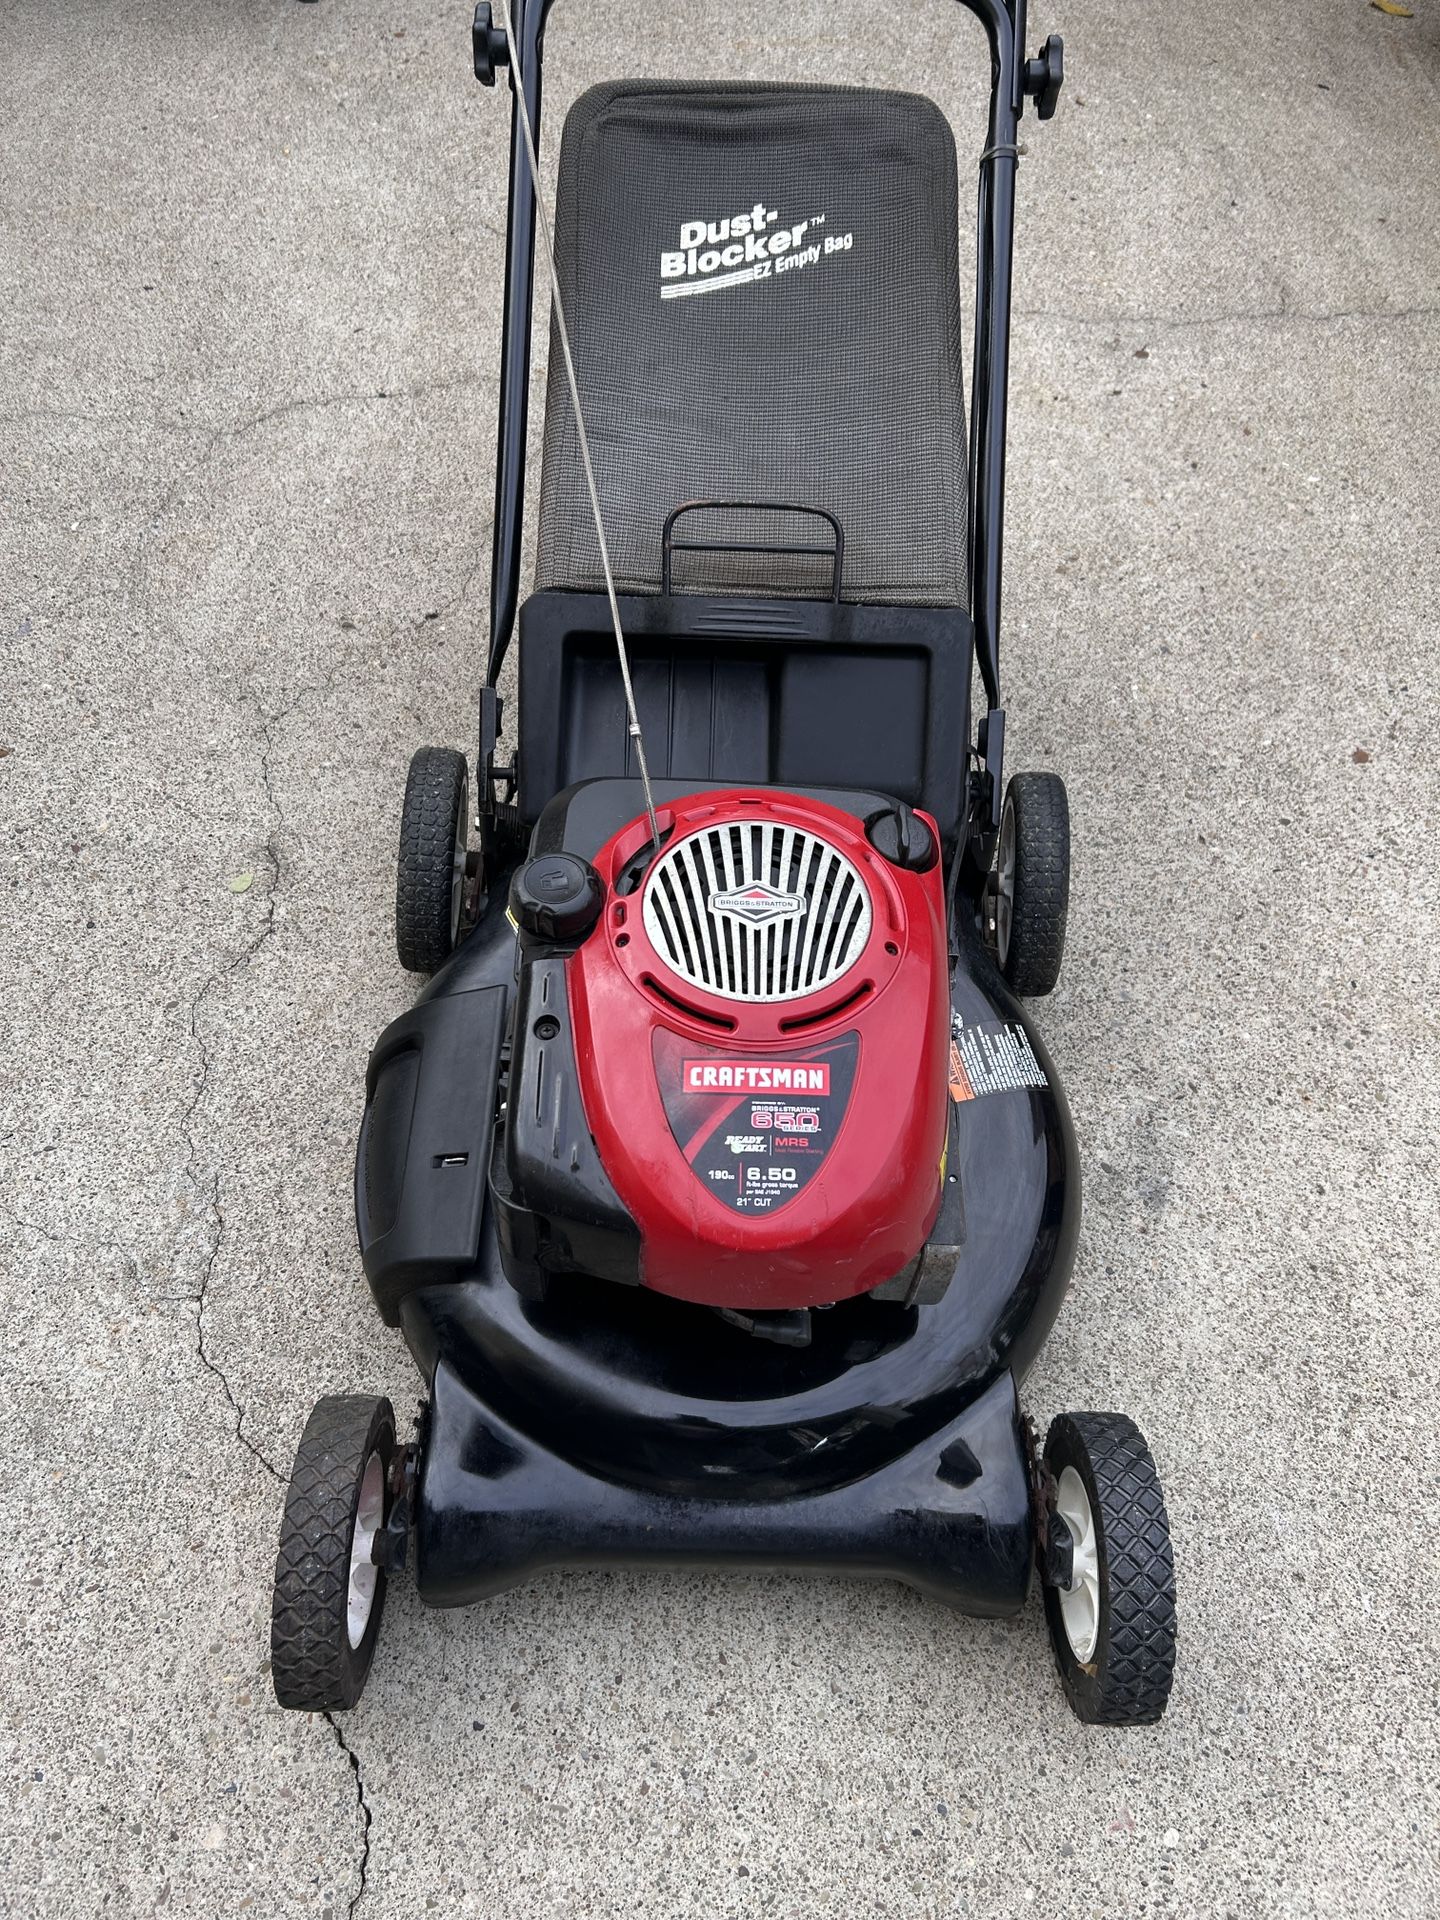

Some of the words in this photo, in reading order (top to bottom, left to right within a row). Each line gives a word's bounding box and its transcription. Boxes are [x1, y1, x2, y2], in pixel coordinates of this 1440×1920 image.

[680, 203, 778, 249] Dust-
[754, 261, 771, 279] EZ
[775, 245, 820, 272] Empty
[825, 233, 853, 254] Bag
[690, 1066, 823, 1089] CRAFTSMAN
[751, 1112, 819, 1129] 650
[775, 1137, 809, 1147] MRS
[747, 1167, 796, 1180] 6.50
[754, 1198, 771, 1206] CUT
